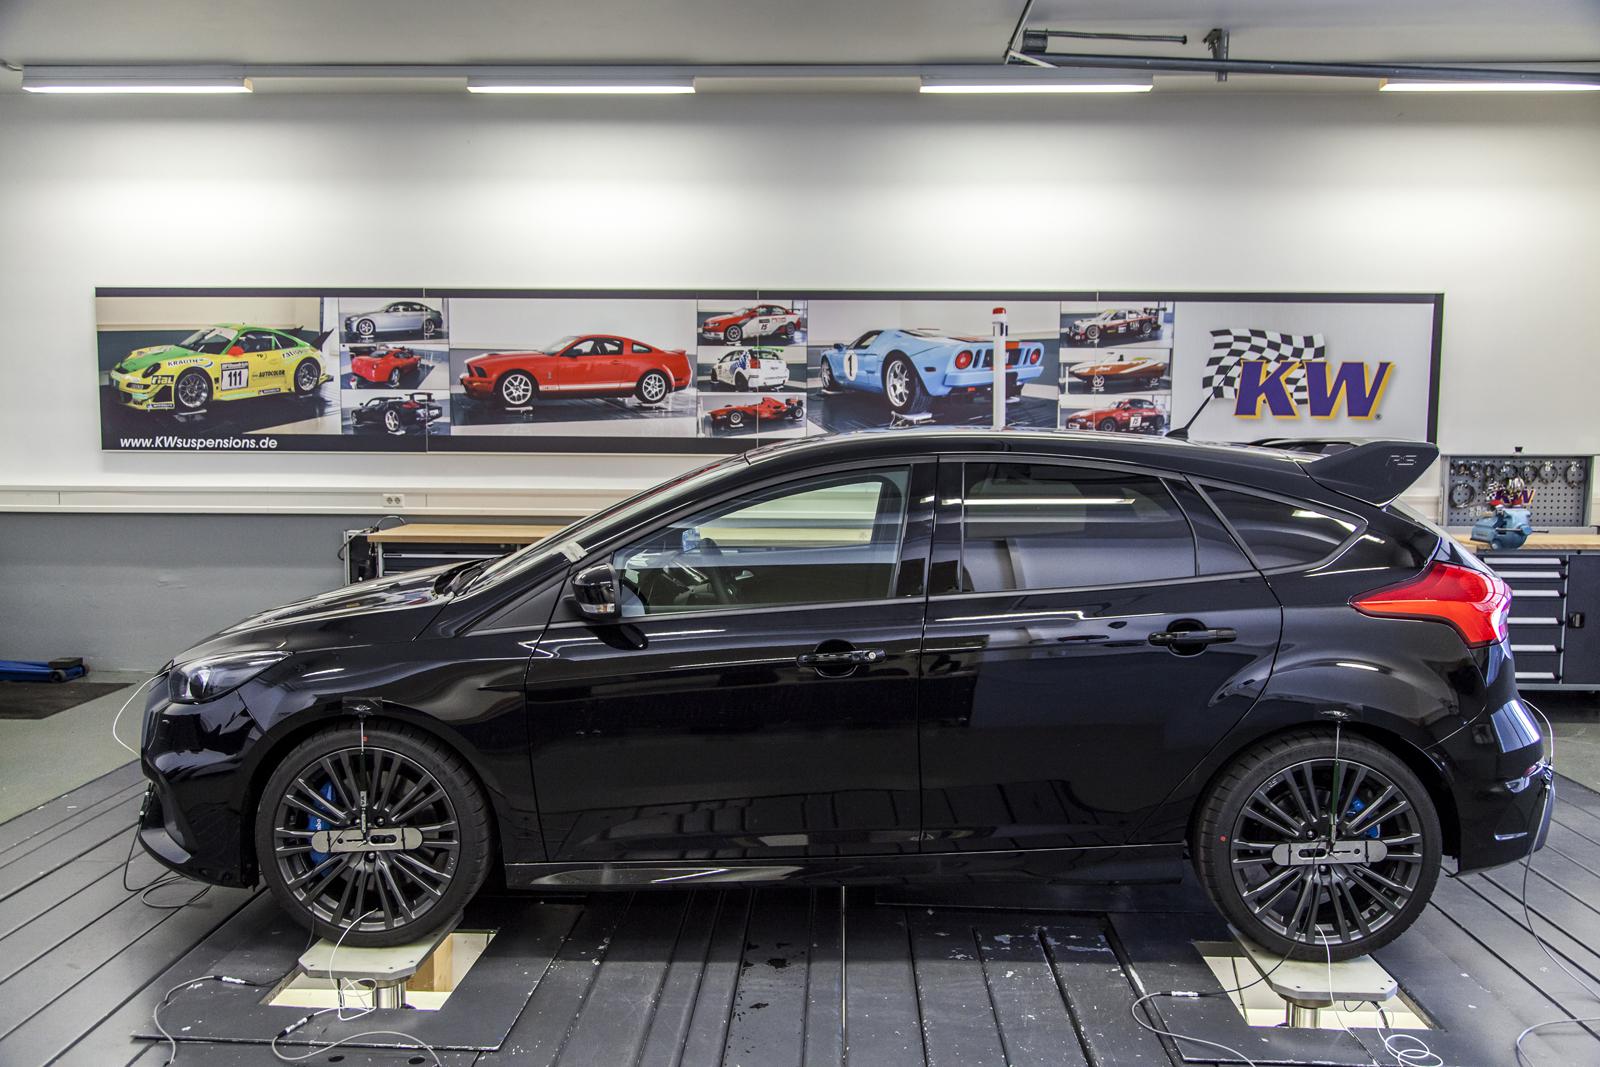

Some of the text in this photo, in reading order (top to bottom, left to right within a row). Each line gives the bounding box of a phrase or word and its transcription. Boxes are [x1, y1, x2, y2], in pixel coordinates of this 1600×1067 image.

[848, 355, 852, 376] 1
[228, 371, 242, 387] 111
[1233, 359, 1394, 420] KW
[119, 435, 278, 450] www.KWsuspensions.de
